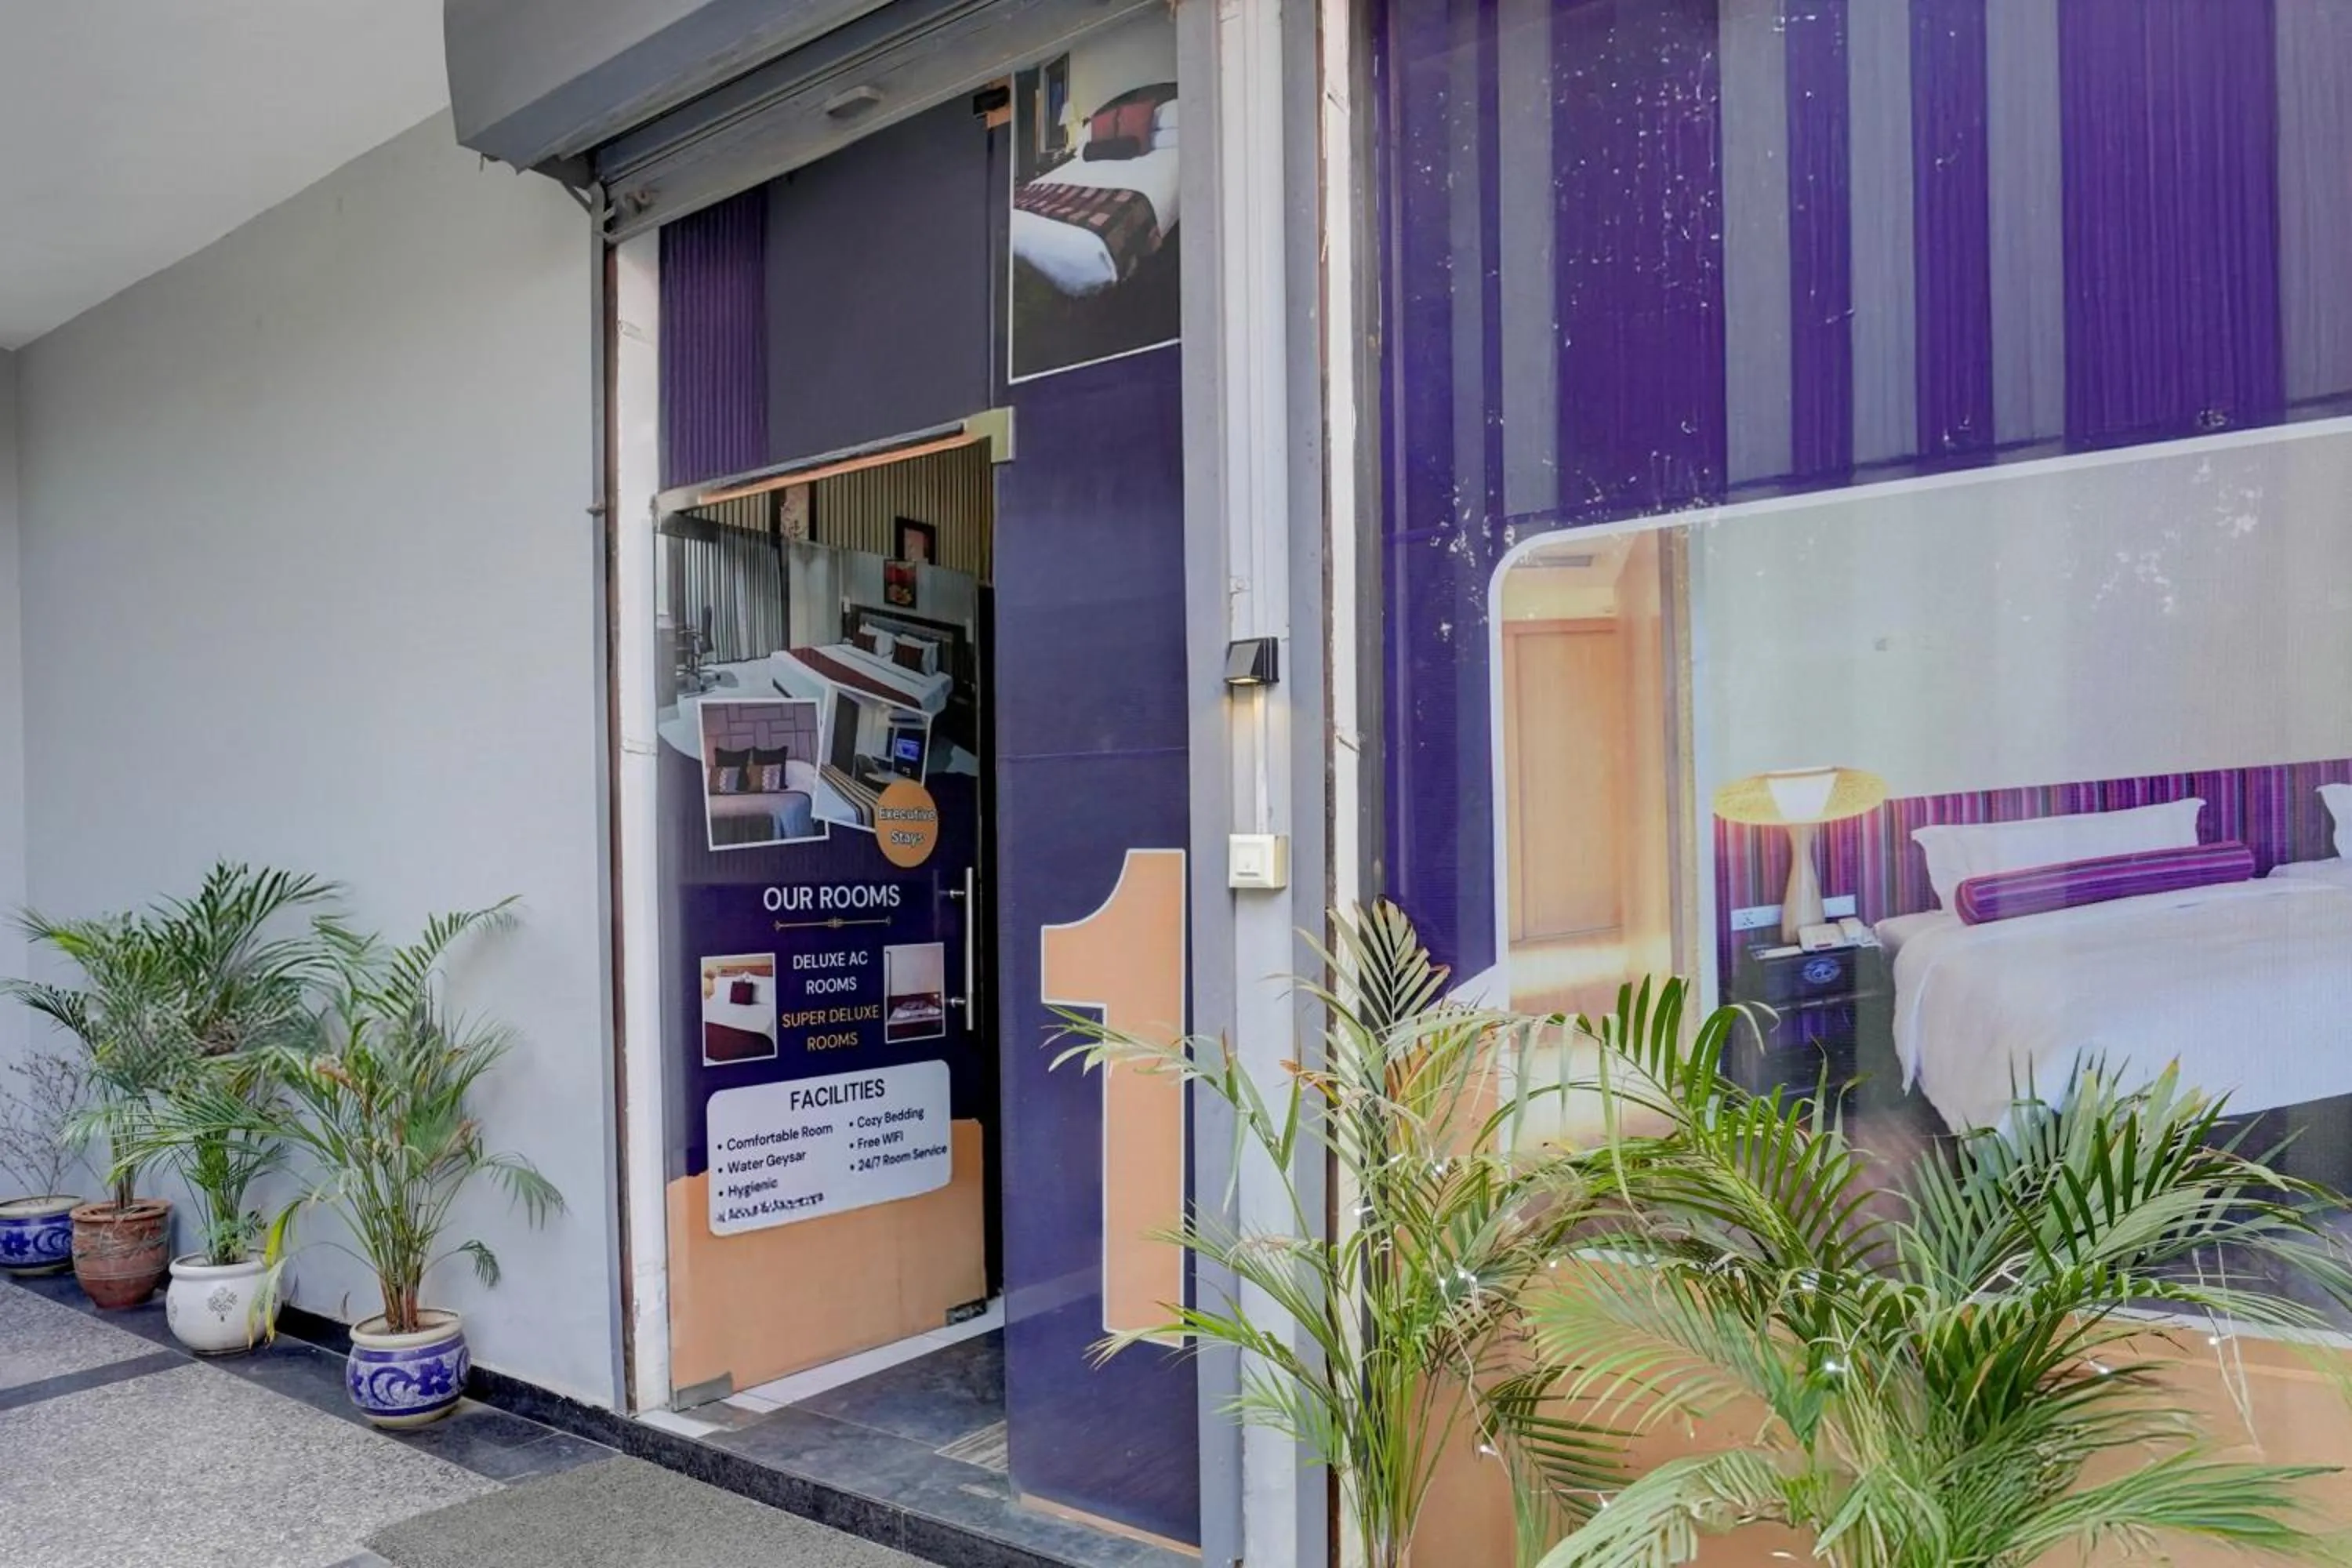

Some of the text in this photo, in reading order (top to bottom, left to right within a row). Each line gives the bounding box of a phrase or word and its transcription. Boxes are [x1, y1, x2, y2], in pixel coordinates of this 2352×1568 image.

[879, 807, 937, 822] Executive
[891, 830, 924, 847] Stays
[763, 884, 901, 911] OUR ROOMS
[793, 951, 868, 970] DELUXE AC
[806, 976, 857, 995] ROOMS
[782, 1005, 879, 1028] SUPER DELUXE
[807, 1032, 858, 1051] ROOMS
[790, 1079, 885, 1111] FACILITIES
[857, 1108, 924, 1127] Cozy Bedding
[727, 1124, 833, 1151] Comfortable Room
[857, 1138, 880, 1148] Free
[727, 1151, 806, 1174] Water Geysar
[858, 1145, 947, 1171] 24/7 Room Service
[728, 1178, 779, 1198] Hygienic
